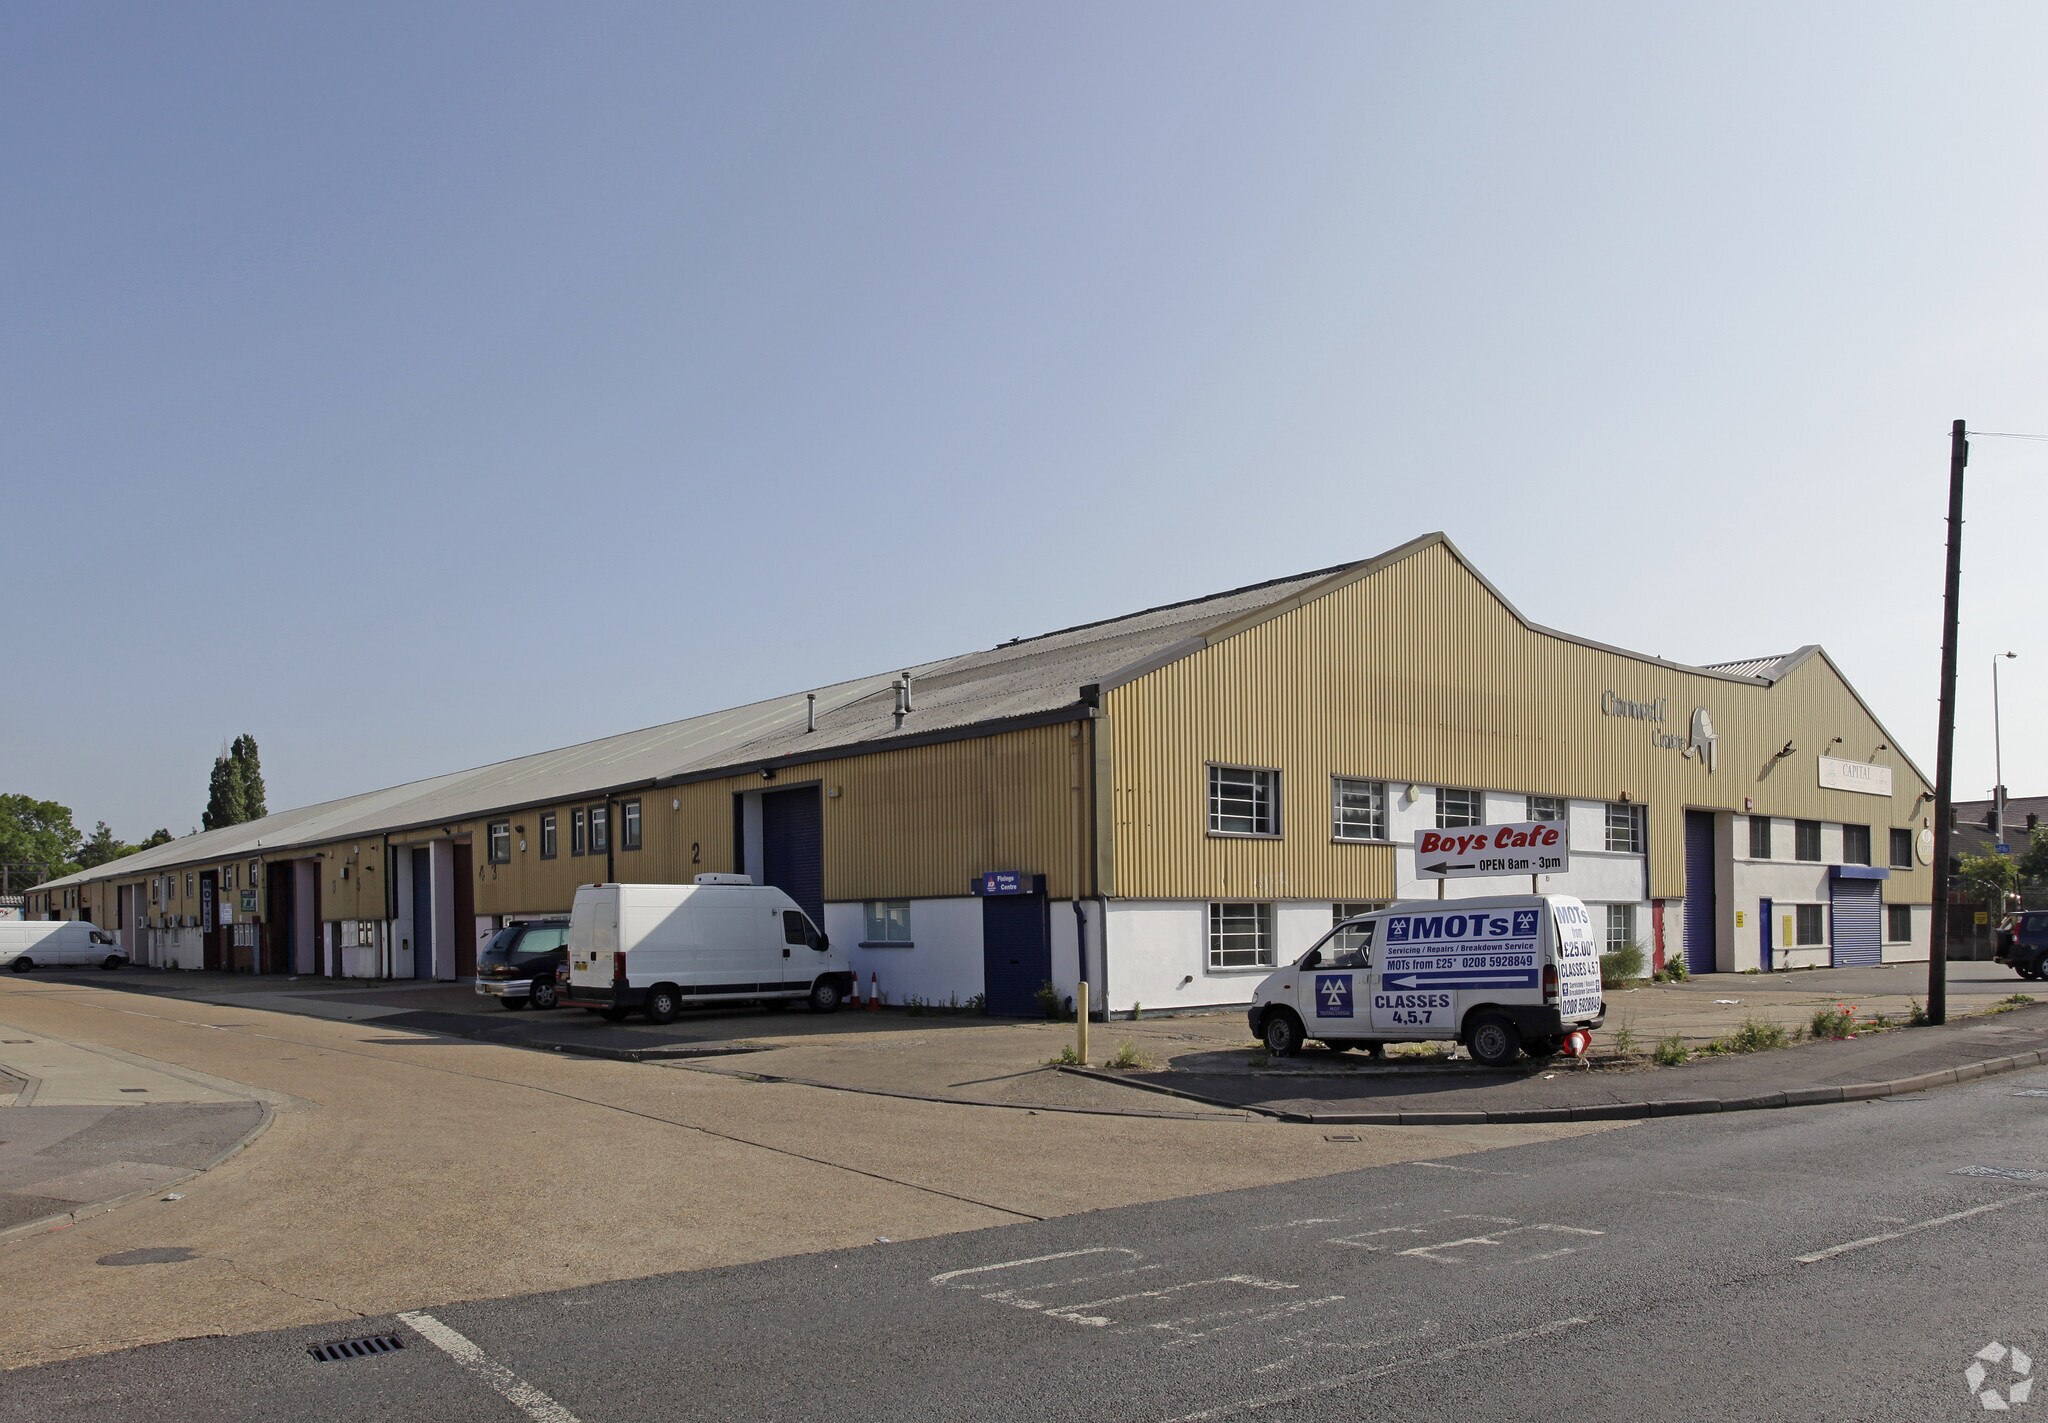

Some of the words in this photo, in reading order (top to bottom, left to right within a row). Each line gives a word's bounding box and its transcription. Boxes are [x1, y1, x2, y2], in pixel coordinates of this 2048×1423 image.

[1842, 763, 1871, 780] CAPITAL
[1420, 832, 1488, 855] Boys
[1494, 824, 1559, 849] Cafe
[692, 842, 700, 864] 2
[1480, 858, 1505, 871] OPEN
[1508, 858, 1529, 869] 8am
[1538, 856, 1561, 869] 3pm
[997, 875, 1014, 883] Fixings
[203, 881, 211, 908] MOT
[1555, 905, 1588, 924] MOTs
[1412, 914, 1509, 939] MOTs
[1571, 926, 1583, 938] from
[1388, 947, 1420, 955] Servicing
[1427, 945, 1454, 954] Repairs
[1461, 944, 1503, 952] Breakdown
[1505, 942, 1534, 950] Service
[1387, 960, 1410, 971] MOTs
[1413, 959, 1433, 969] from
[1462, 957, 1486, 968] 0208
[1489, 955, 1533, 967] 5928849
[1561, 962, 1587, 978] CLASSES
[1374, 994, 1450, 1009] CLASSES
[1562, 998, 1577, 1015] 0208
[1392, 1010, 1433, 1025] 4,5,7
